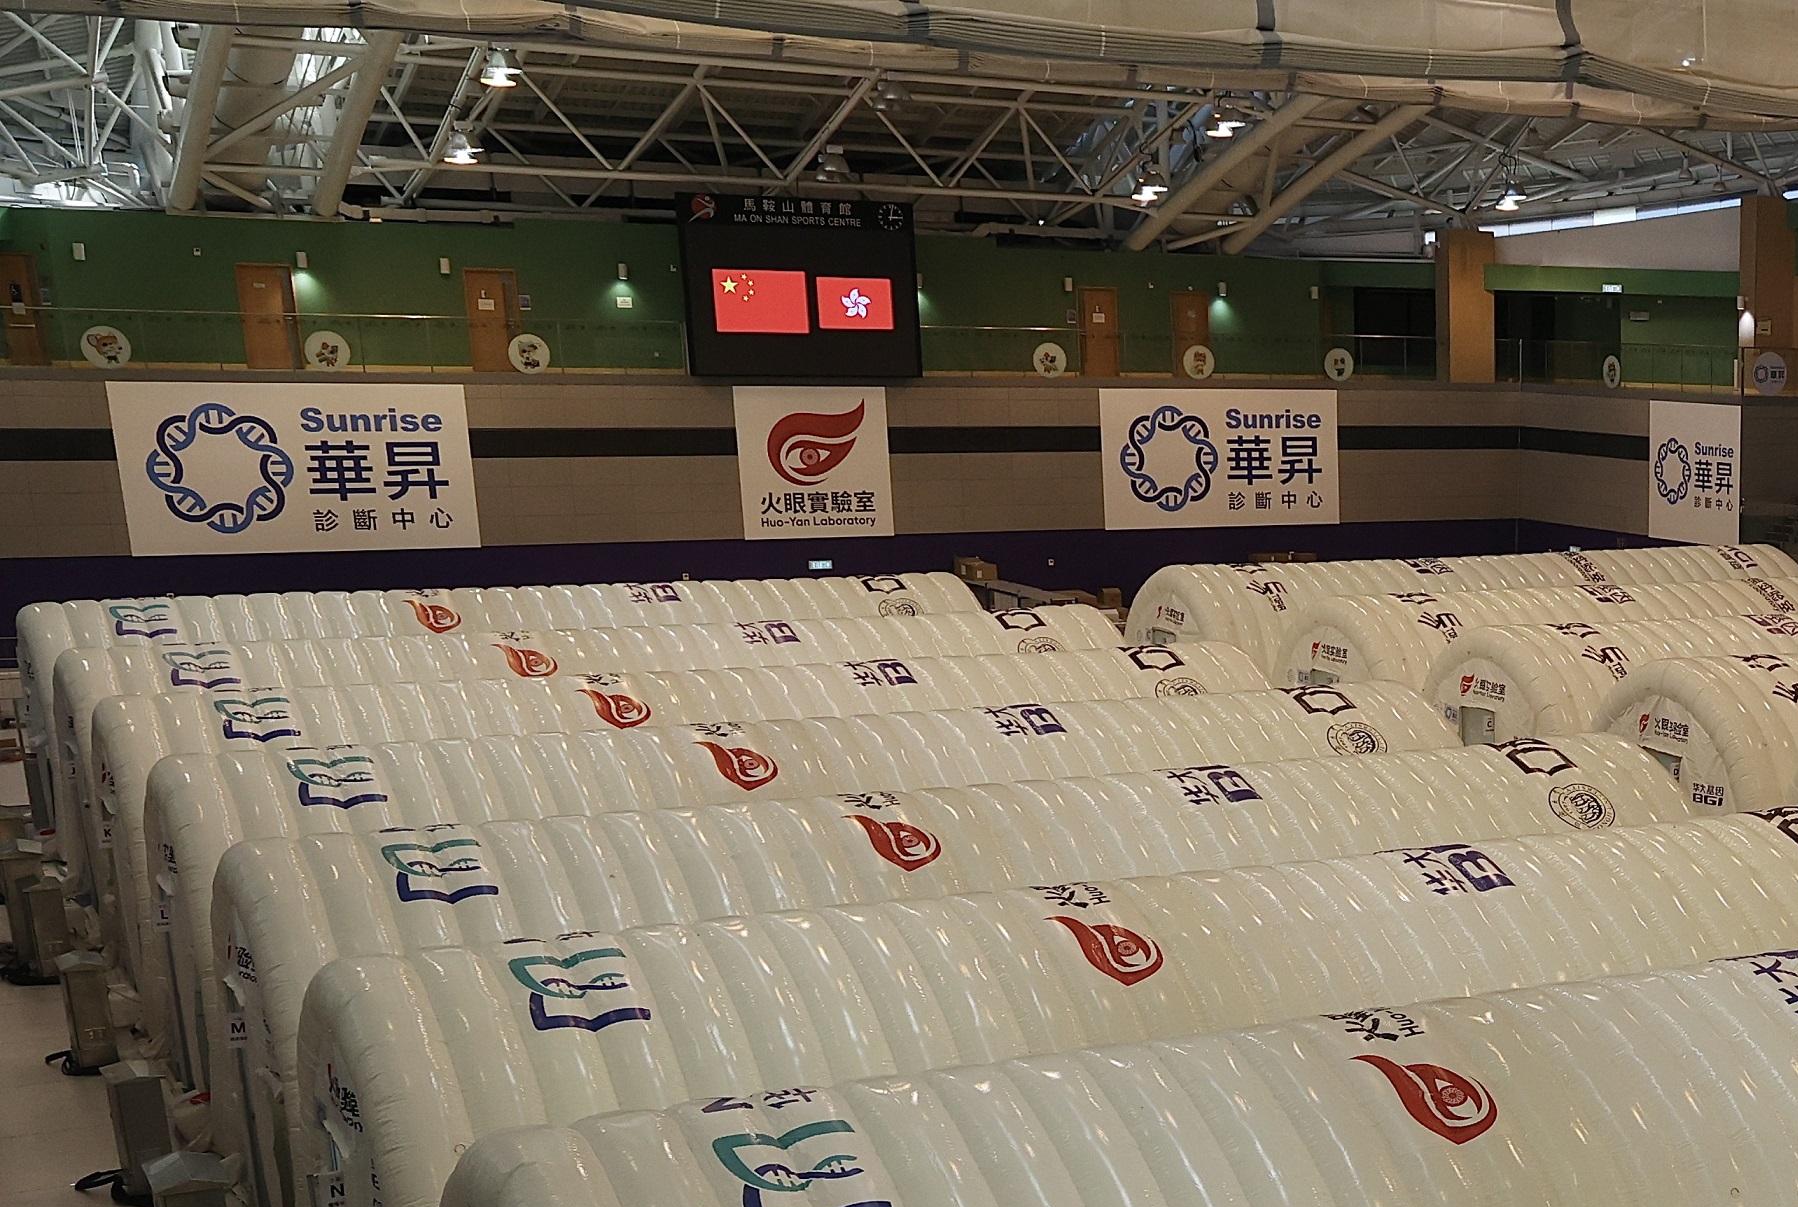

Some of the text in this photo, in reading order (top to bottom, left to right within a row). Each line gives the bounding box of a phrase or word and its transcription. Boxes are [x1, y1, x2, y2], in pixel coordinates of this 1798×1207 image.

[743, 198, 852, 216] 馬鞍山體育館
[733, 212, 862, 228] MA ON SHAN SPORTS CENTRE
[300, 407, 443, 433] Sunrise
[1225, 408, 1322, 429] Sunrise
[1694, 441, 1734, 458] Sunrise
[1226, 435, 1323, 486] 華昇
[304, 440, 449, 502] 華昇
[1693, 459, 1734, 495] 華昇
[760, 490, 876, 515] 火眼實驗室
[1227, 490, 1324, 511] 診斷中心
[312, 507, 454, 532] 診斷中心
[760, 515, 876, 528] Huo-Yan Laboratory
[1692, 793, 1724, 807] BGI
[160, 909, 169, 920] L
[230, 1021, 246, 1034] M
[330, 1183, 345, 1199] N
